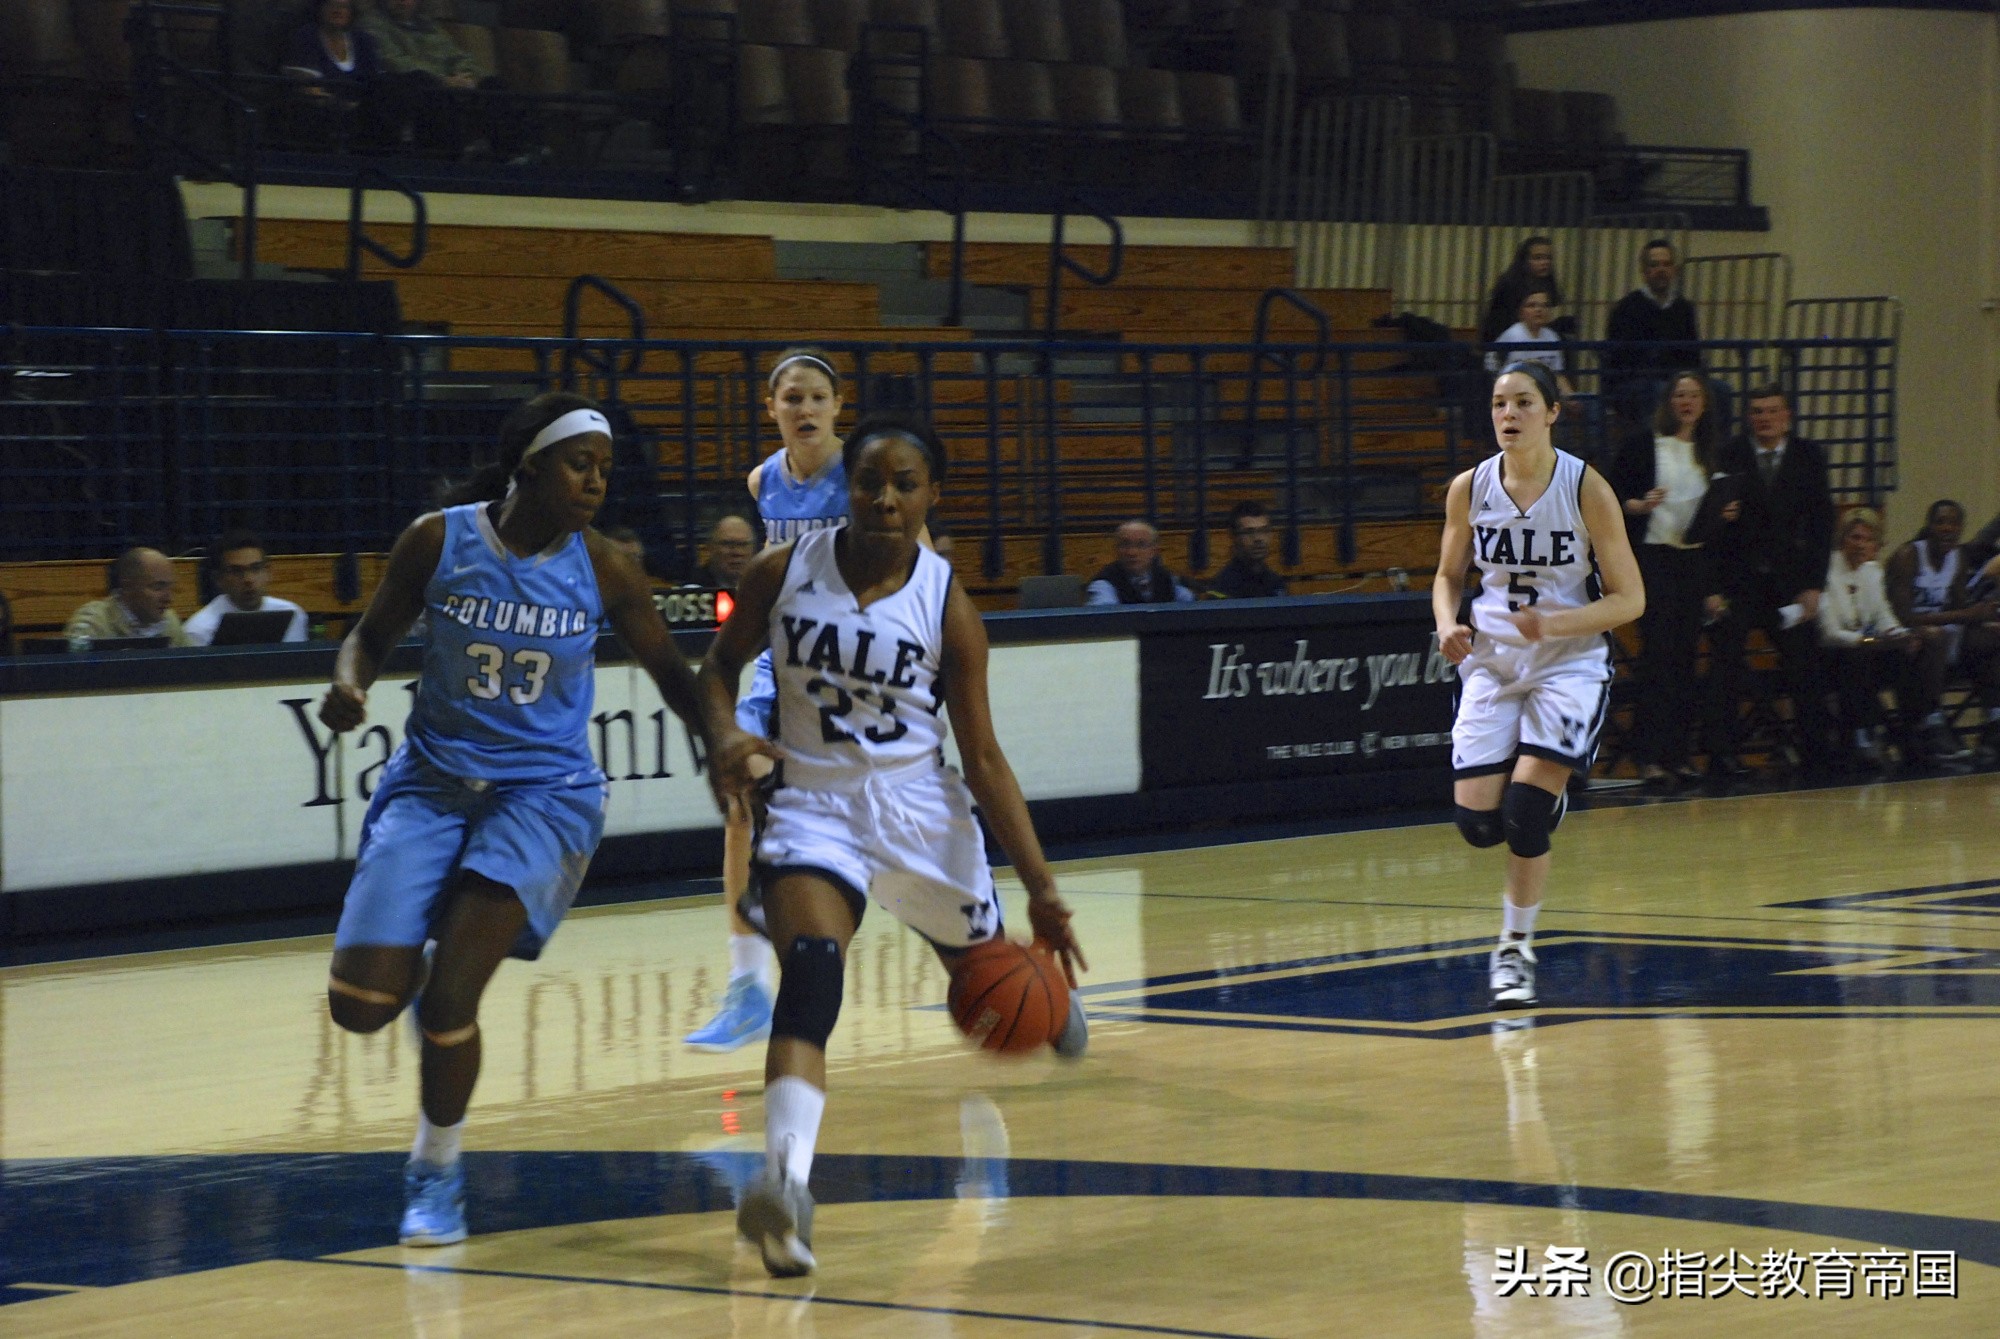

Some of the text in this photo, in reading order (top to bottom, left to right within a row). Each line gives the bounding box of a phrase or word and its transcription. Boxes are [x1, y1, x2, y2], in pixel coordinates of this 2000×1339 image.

[1475, 524, 1576, 567] YALE
[443, 594, 588, 638] COLUMBIA
[1508, 571, 1539, 612] 5
[464, 641, 553, 706] 33
[781, 615, 926, 689] YALE
[1202, 643, 1253, 700] It's
[1256, 639, 1359, 696] where
[1361, 652, 1421, 711] you
[805, 678, 910, 745] 23
